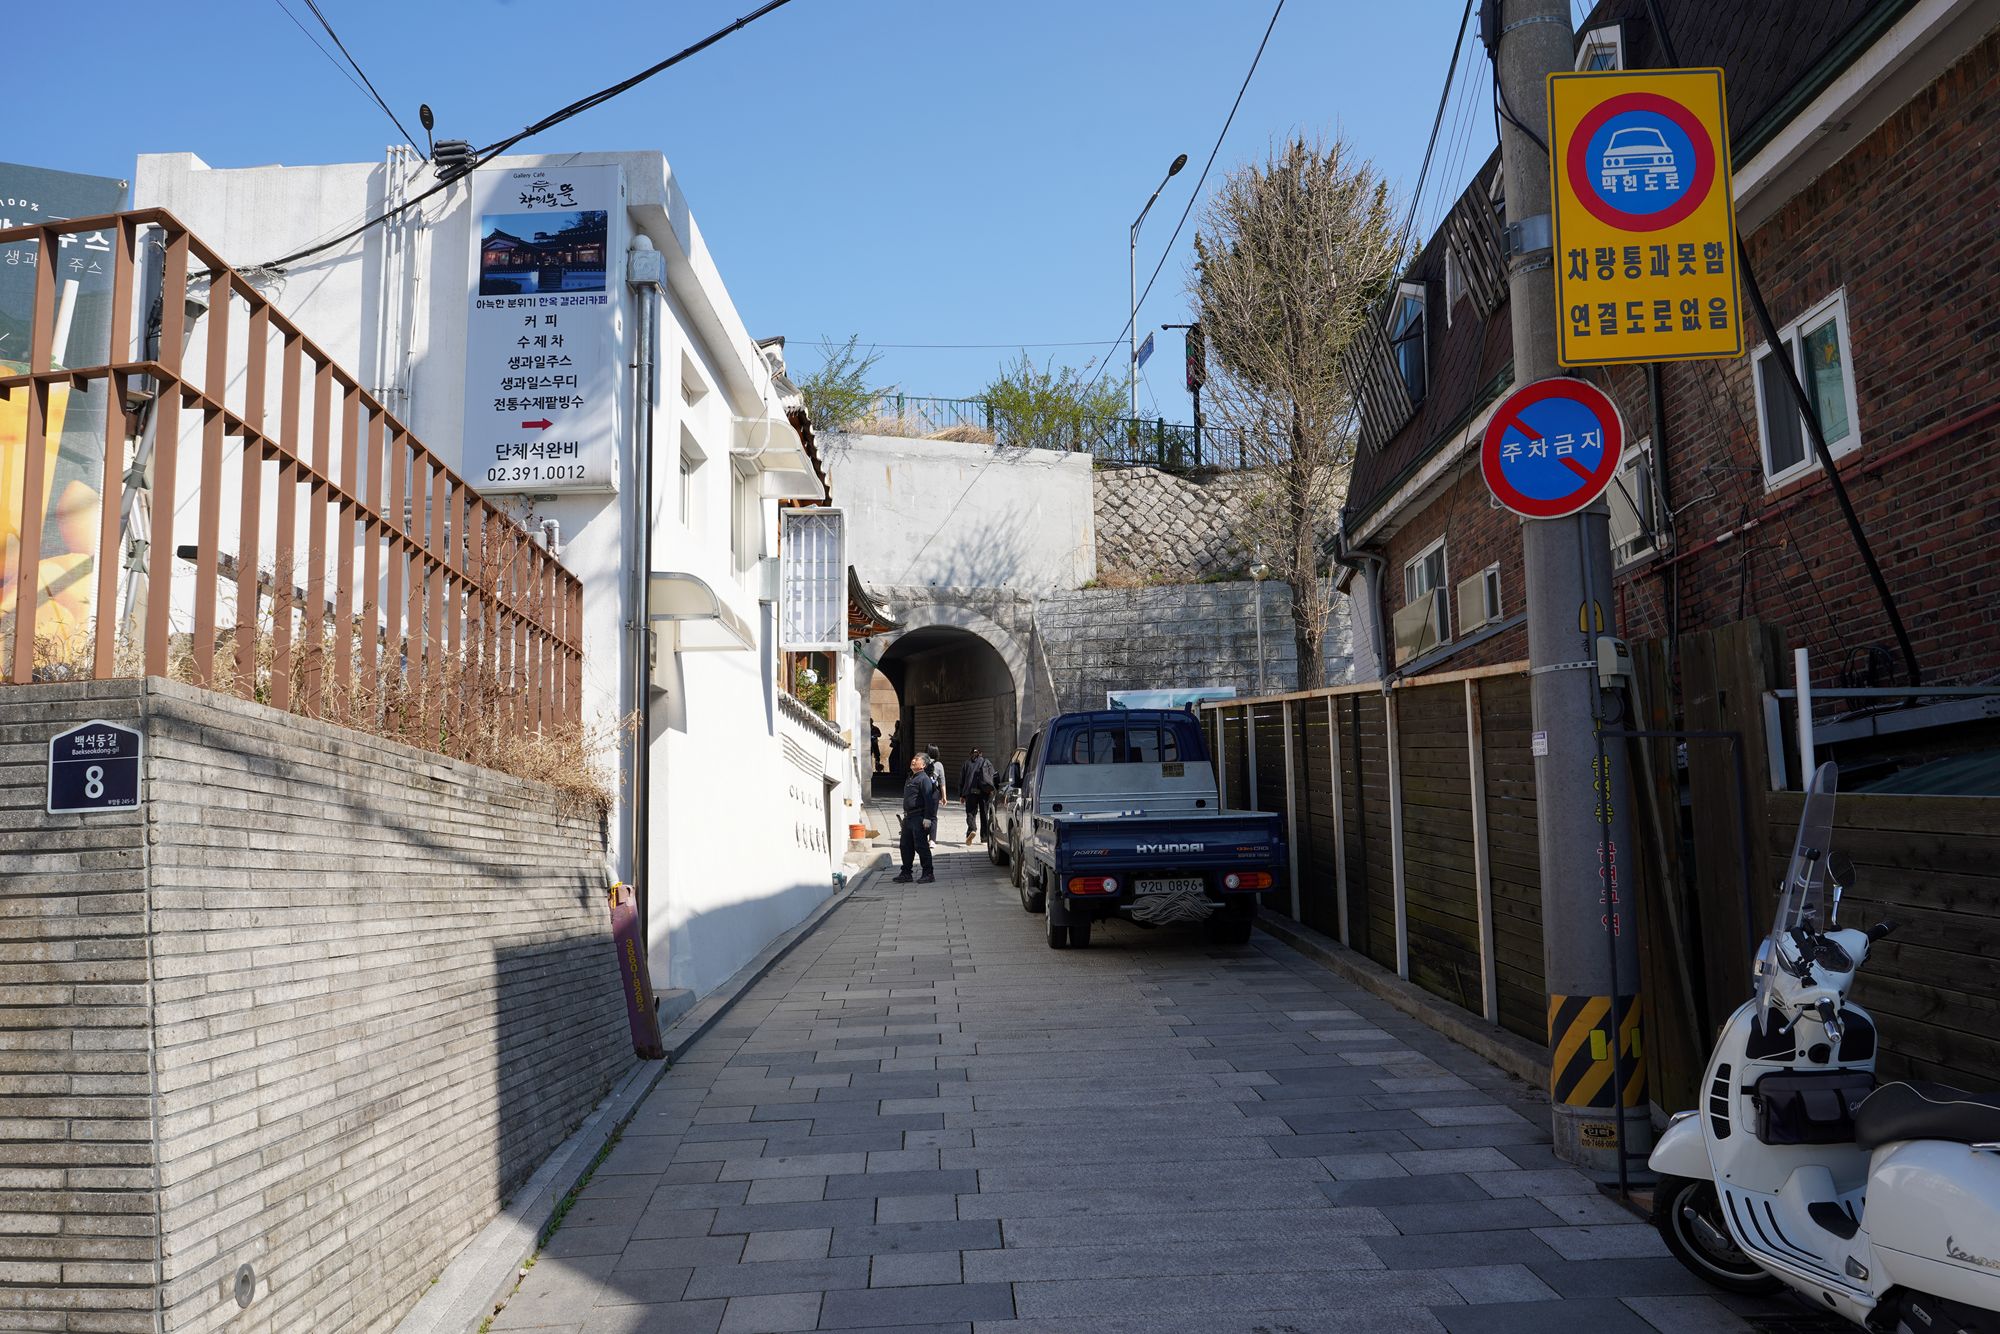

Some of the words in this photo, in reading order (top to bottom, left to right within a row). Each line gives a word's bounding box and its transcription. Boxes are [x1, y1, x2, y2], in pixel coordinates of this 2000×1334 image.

[1567, 241, 1725, 281] 차량통과못함
[476, 299, 504, 309] 아늑한
[507, 298, 536, 308] 분위기
[539, 297, 558, 306] 한옥
[560, 295, 608, 306] 갤러리카페
[1570, 297, 1728, 337] 연결도로없음
[508, 355, 572, 370] 생과일주스
[500, 374, 578, 391] 생과일스무디
[493, 395, 585, 412] 전통수제팥빙수
[495, 441, 579, 461] 단체석완비
[1502, 428, 1601, 463] 주차금지
[487, 465, 586, 482] 02.391.0012
[74, 733, 117, 748] 백석동길
[71, 747, 120, 756] Baekseokdong-gil
[84, 765, 104, 799] 8
[1136, 843, 1204, 854] HYUNDAI
[1168, 879, 1198, 892] 0896
